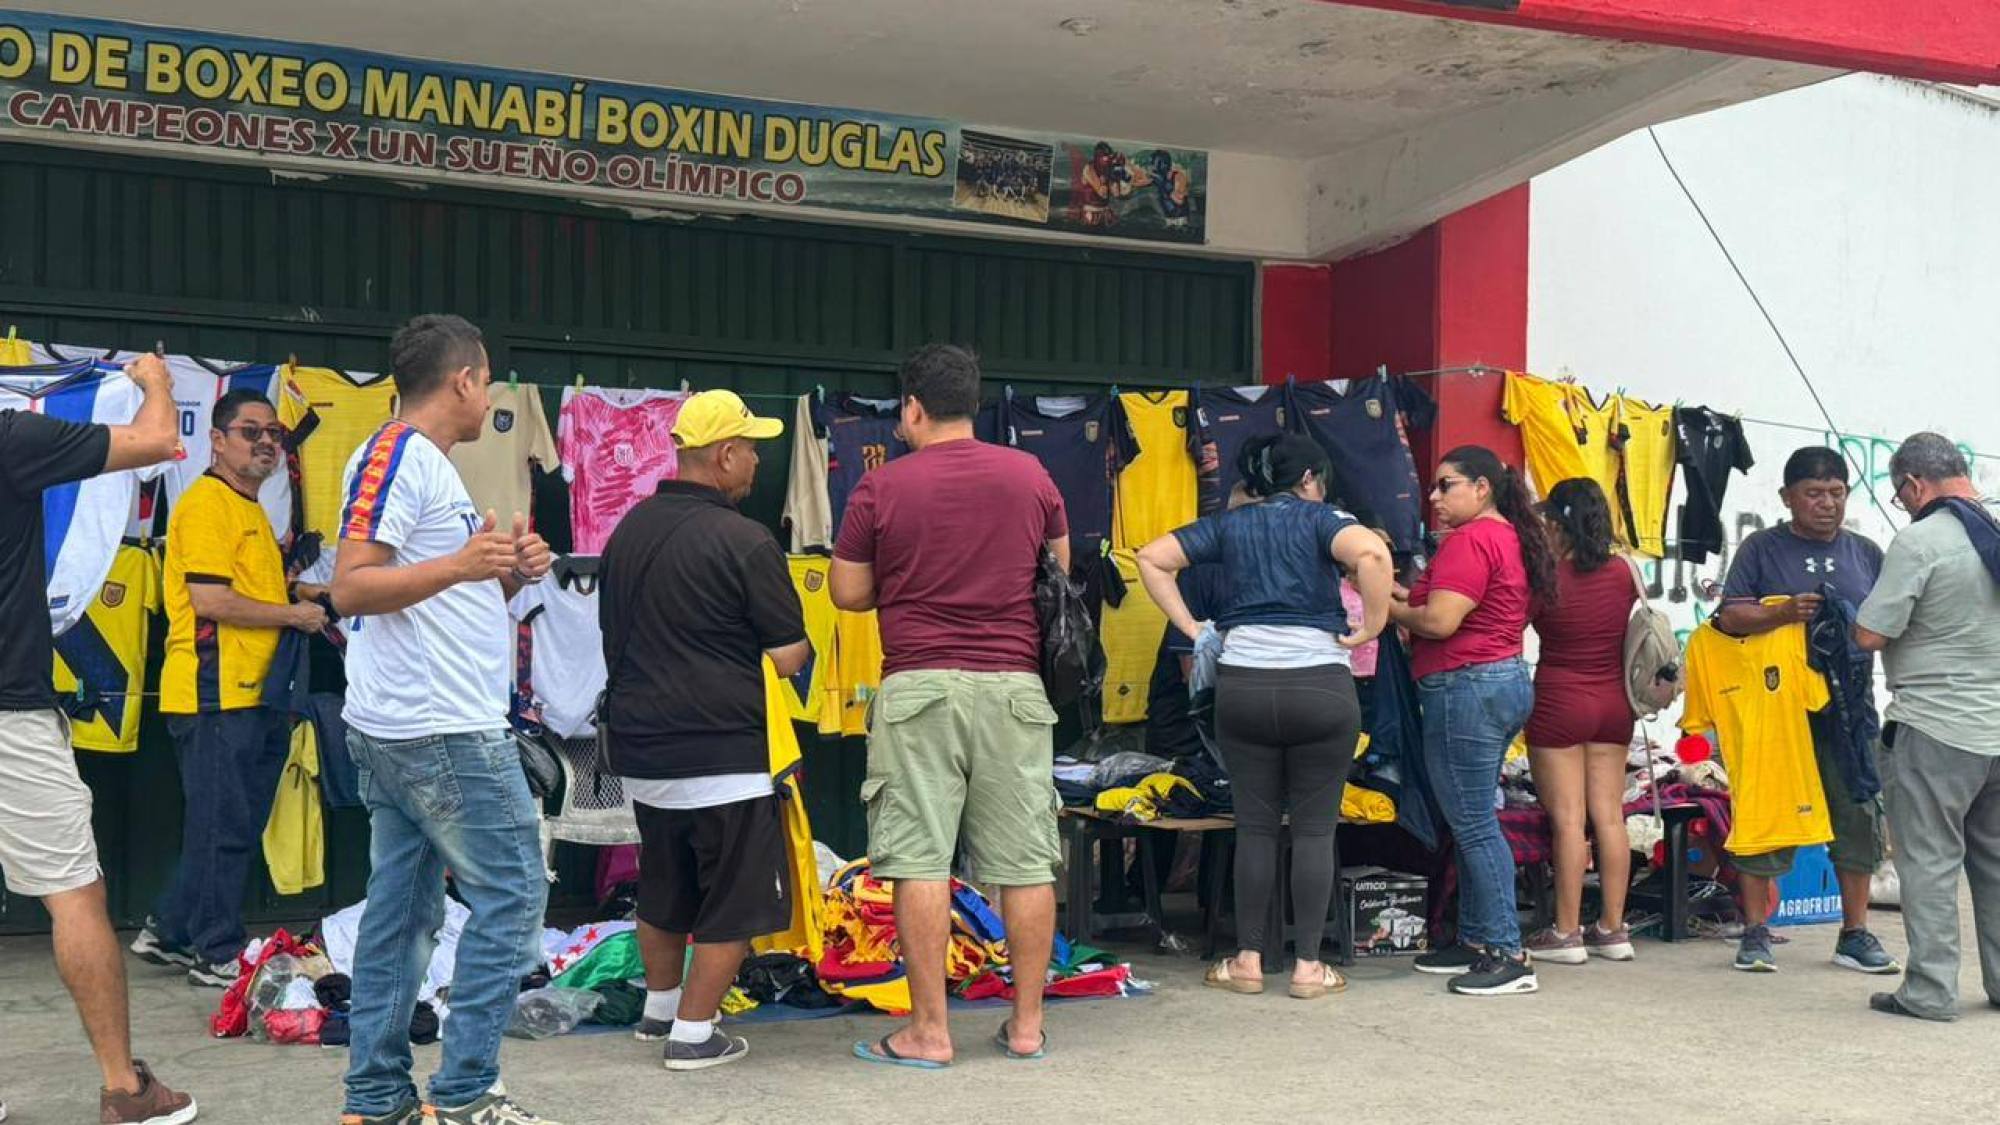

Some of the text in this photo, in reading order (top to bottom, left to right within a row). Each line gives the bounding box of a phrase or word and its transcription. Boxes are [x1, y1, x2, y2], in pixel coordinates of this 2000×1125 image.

[9, 91, 805, 202] CAMPEONES X UN SUEÑO OLÍMPICO
[50, 33, 129, 90] DE
[147, 44, 349, 112] BOXEO
[365, 69, 584, 140] MANABÍ
[597, 98, 752, 159] BOXIN
[765, 119, 945, 178] DUGLAS
